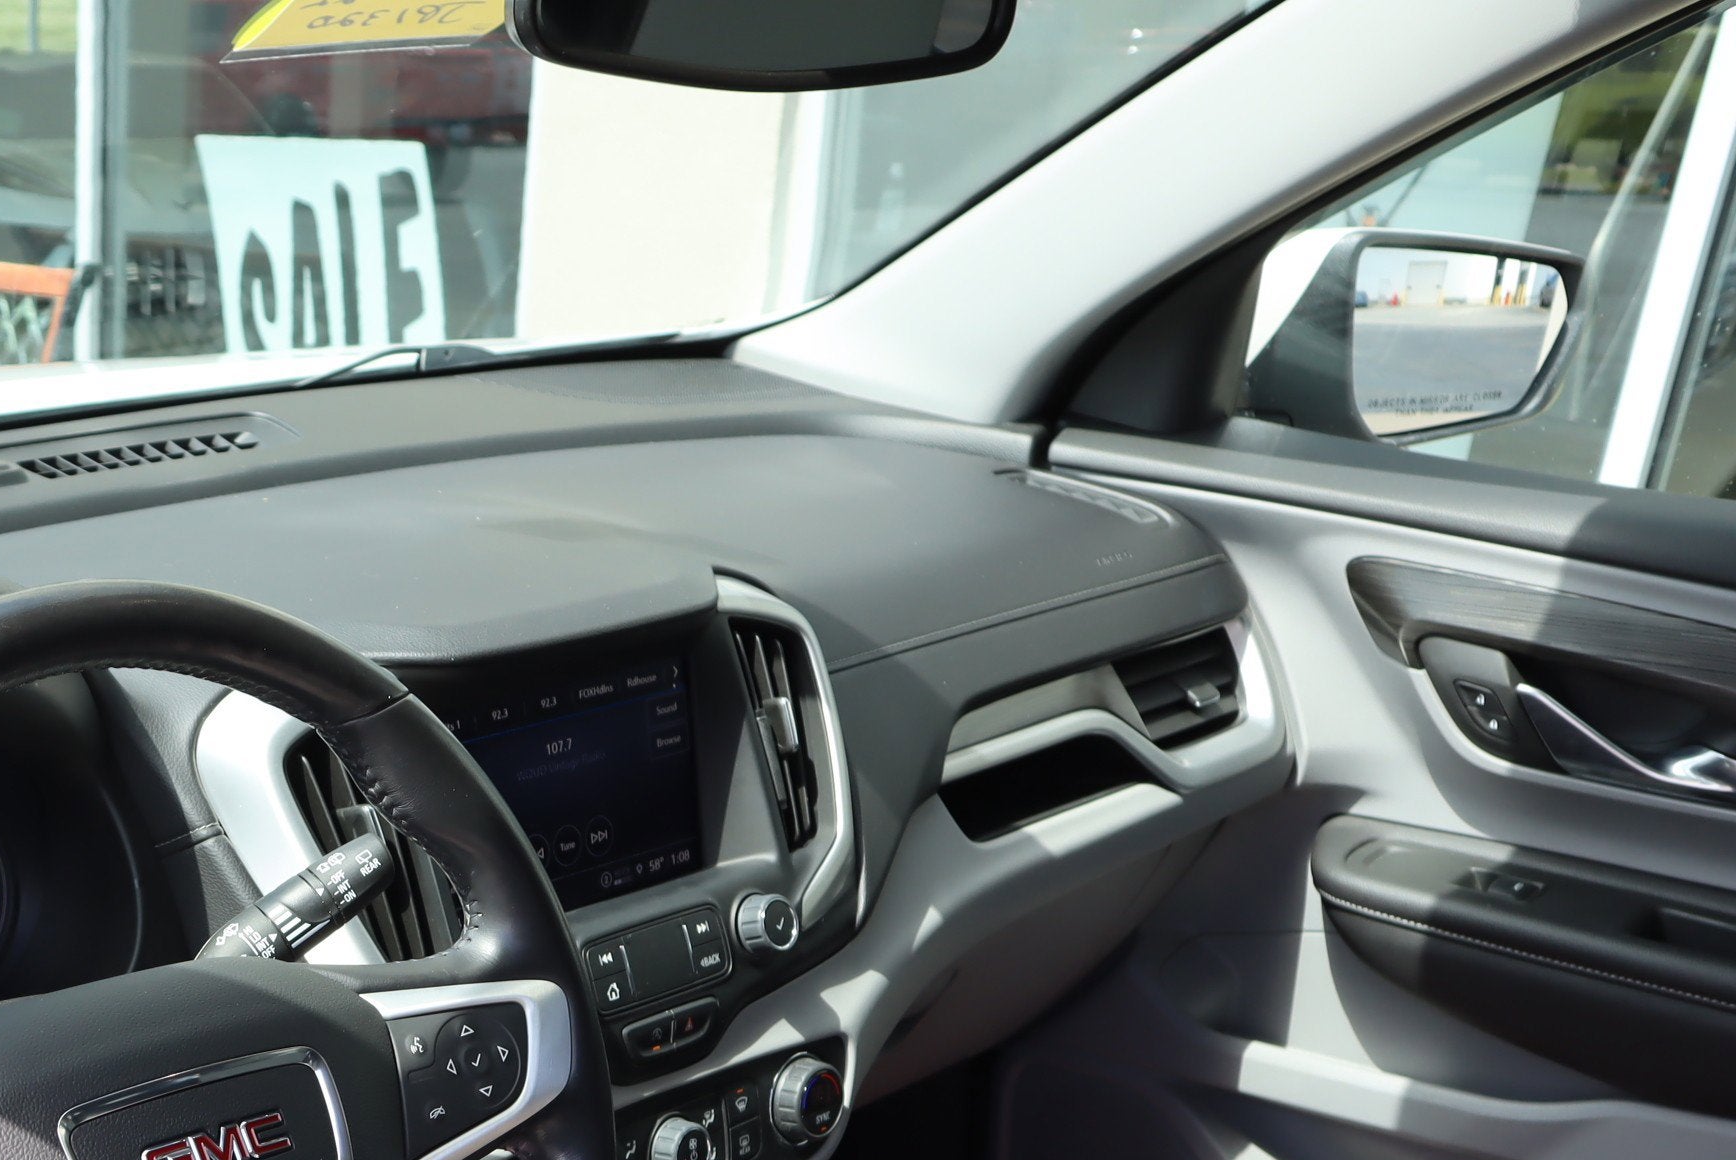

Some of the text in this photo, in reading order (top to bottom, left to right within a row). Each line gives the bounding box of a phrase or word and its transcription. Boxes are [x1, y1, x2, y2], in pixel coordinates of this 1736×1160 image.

[492, 708, 509, 720] 92.3
[541, 697, 557, 709] 92.3
[626, 674, 657, 688] Rdhouse
[656, 702, 678, 716] Sound
[546, 738, 572, 756] 107.7
[656, 734, 682, 748] Browse
[560, 842, 576, 851] Tune
[671, 850, 690, 865] 1:08
[360, 858, 381, 877] REAR
[337, 879, 351, 894] INT
[344, 889, 356, 902] ON
[261, 944, 275, 958] OFF
[703, 952, 721, 967] BACK
[816, 1111, 830, 1124] SYNC
